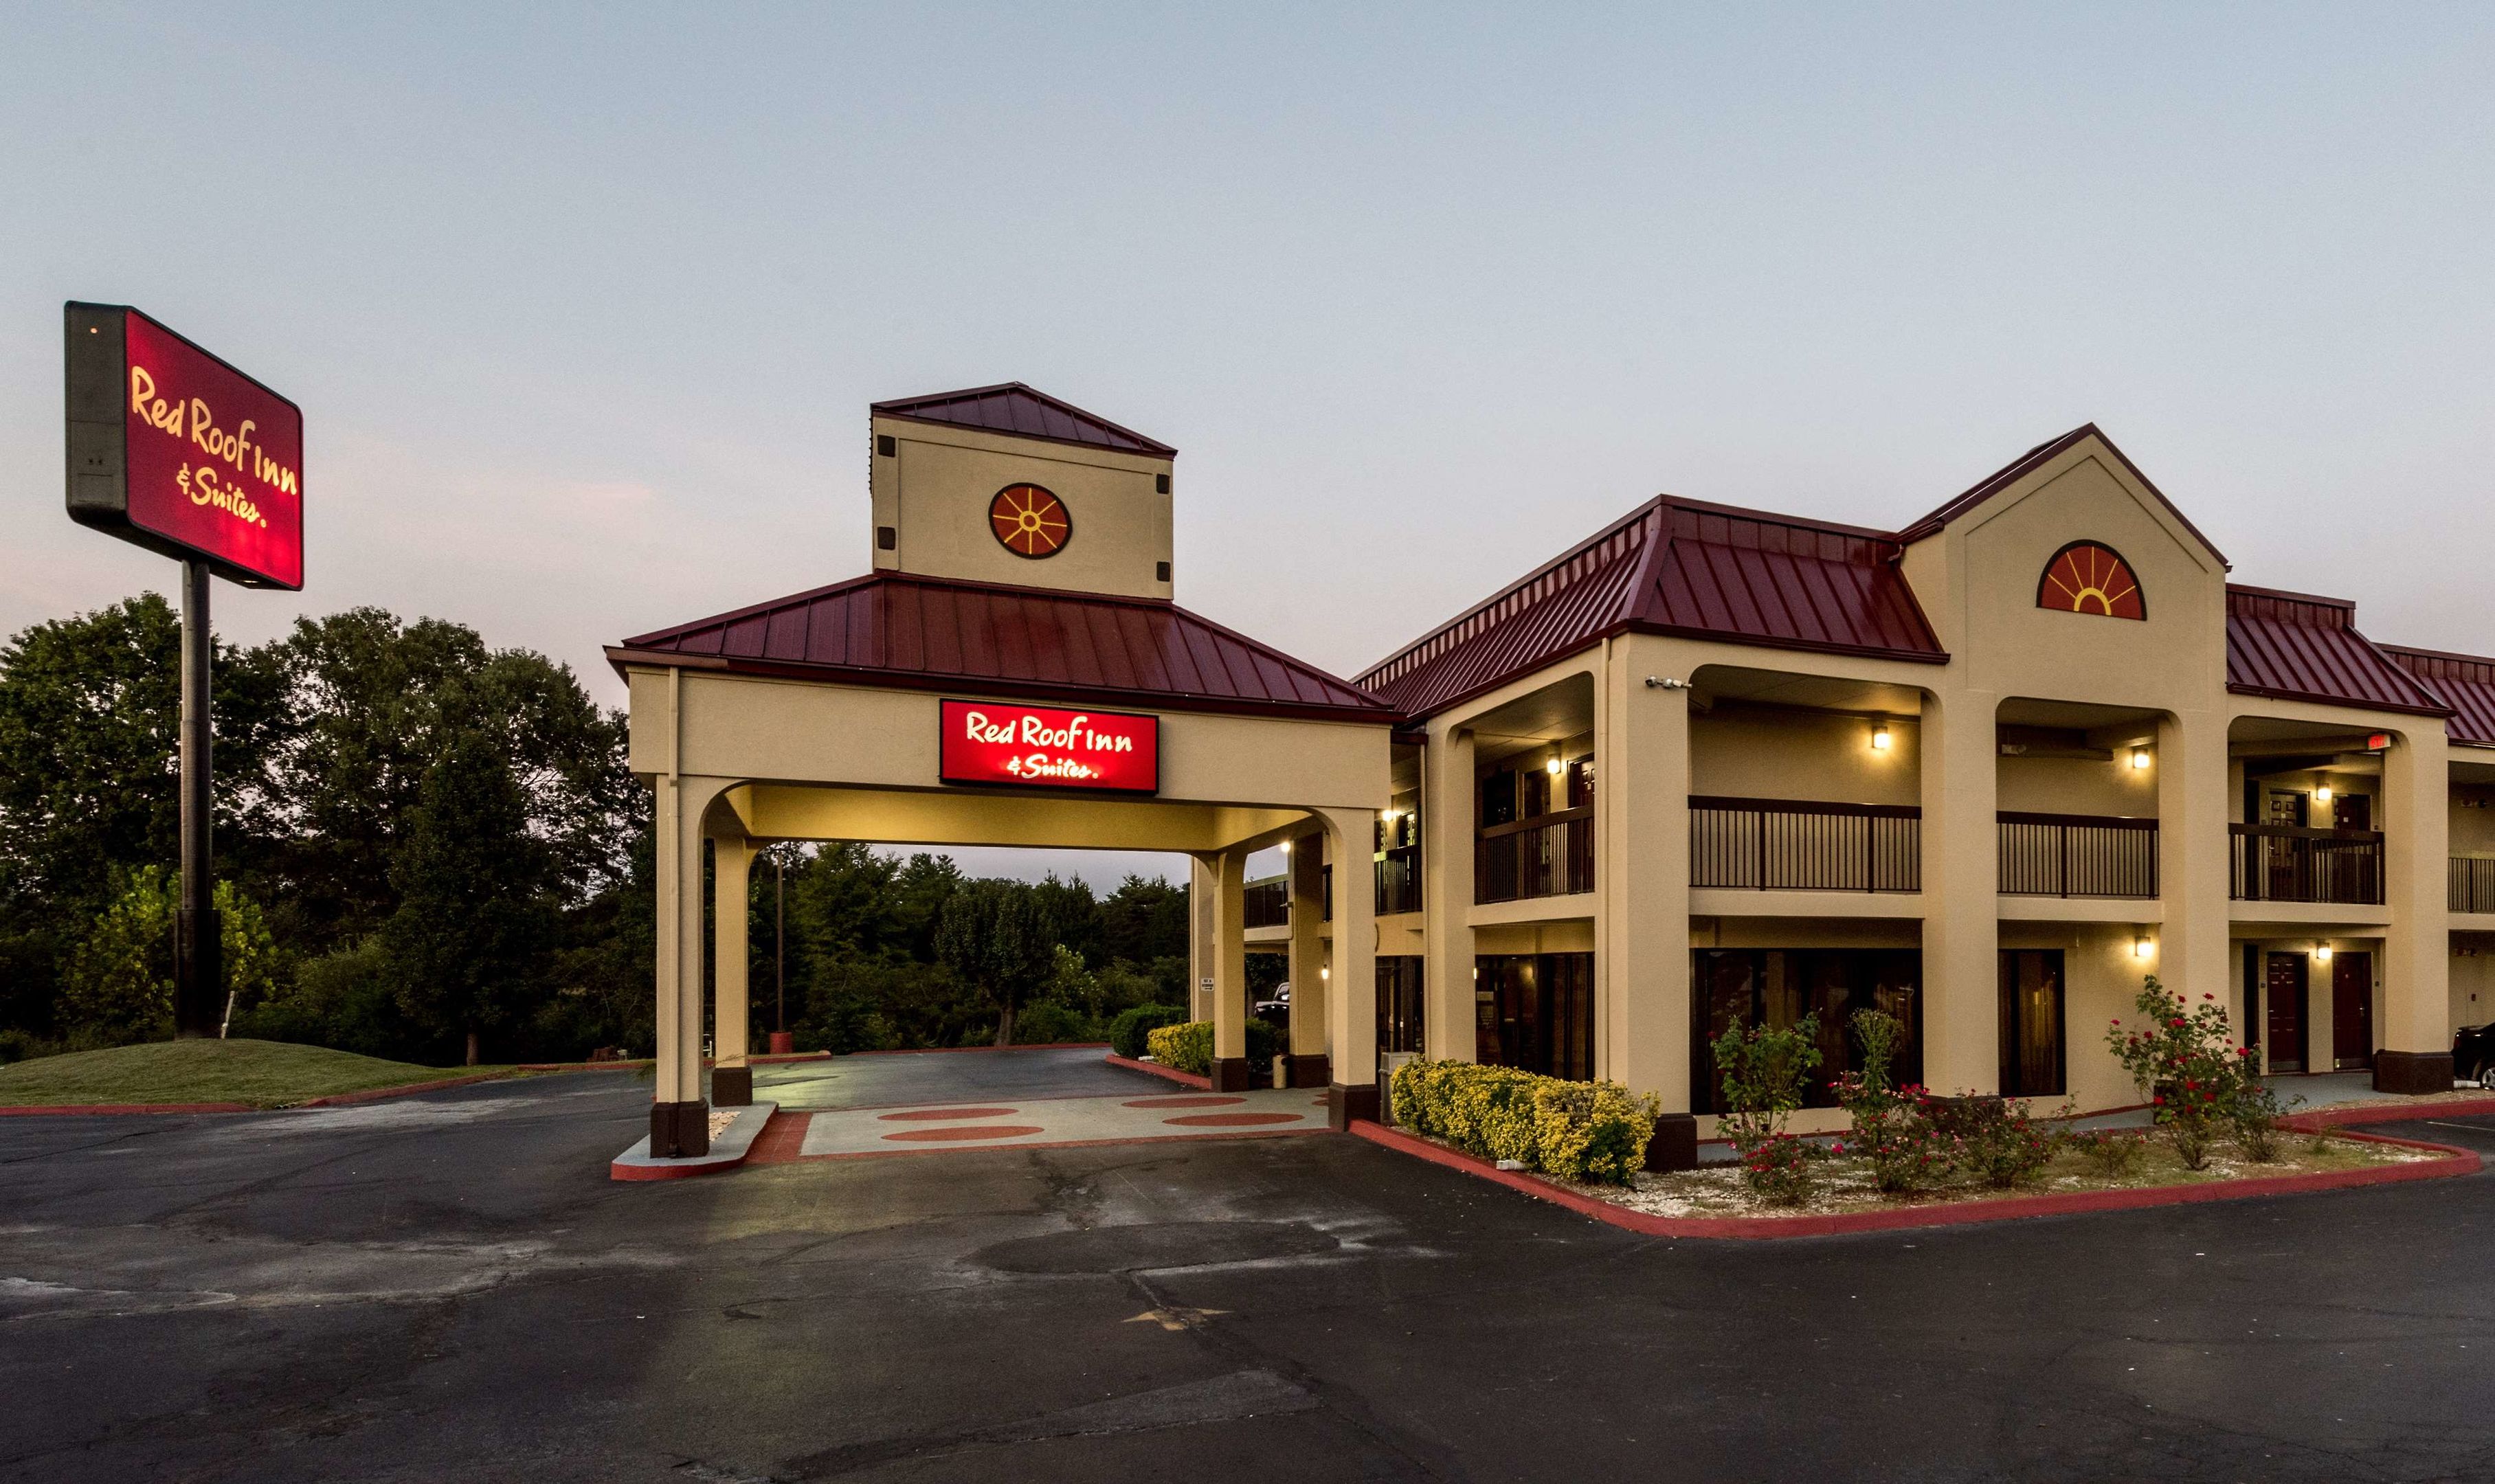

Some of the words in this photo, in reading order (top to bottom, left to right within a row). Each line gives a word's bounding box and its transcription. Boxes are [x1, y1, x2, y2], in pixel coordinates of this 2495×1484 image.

[131, 366, 186, 438] Red
[192, 398, 256, 471] Roof
[255, 445, 298, 495] Inn
[177, 462, 191, 495] &
[966, 711, 1016, 743] Red
[1022, 715, 1088, 750] Roof
[1086, 729, 1132, 752] Inn
[1006, 755, 1022, 776] &
